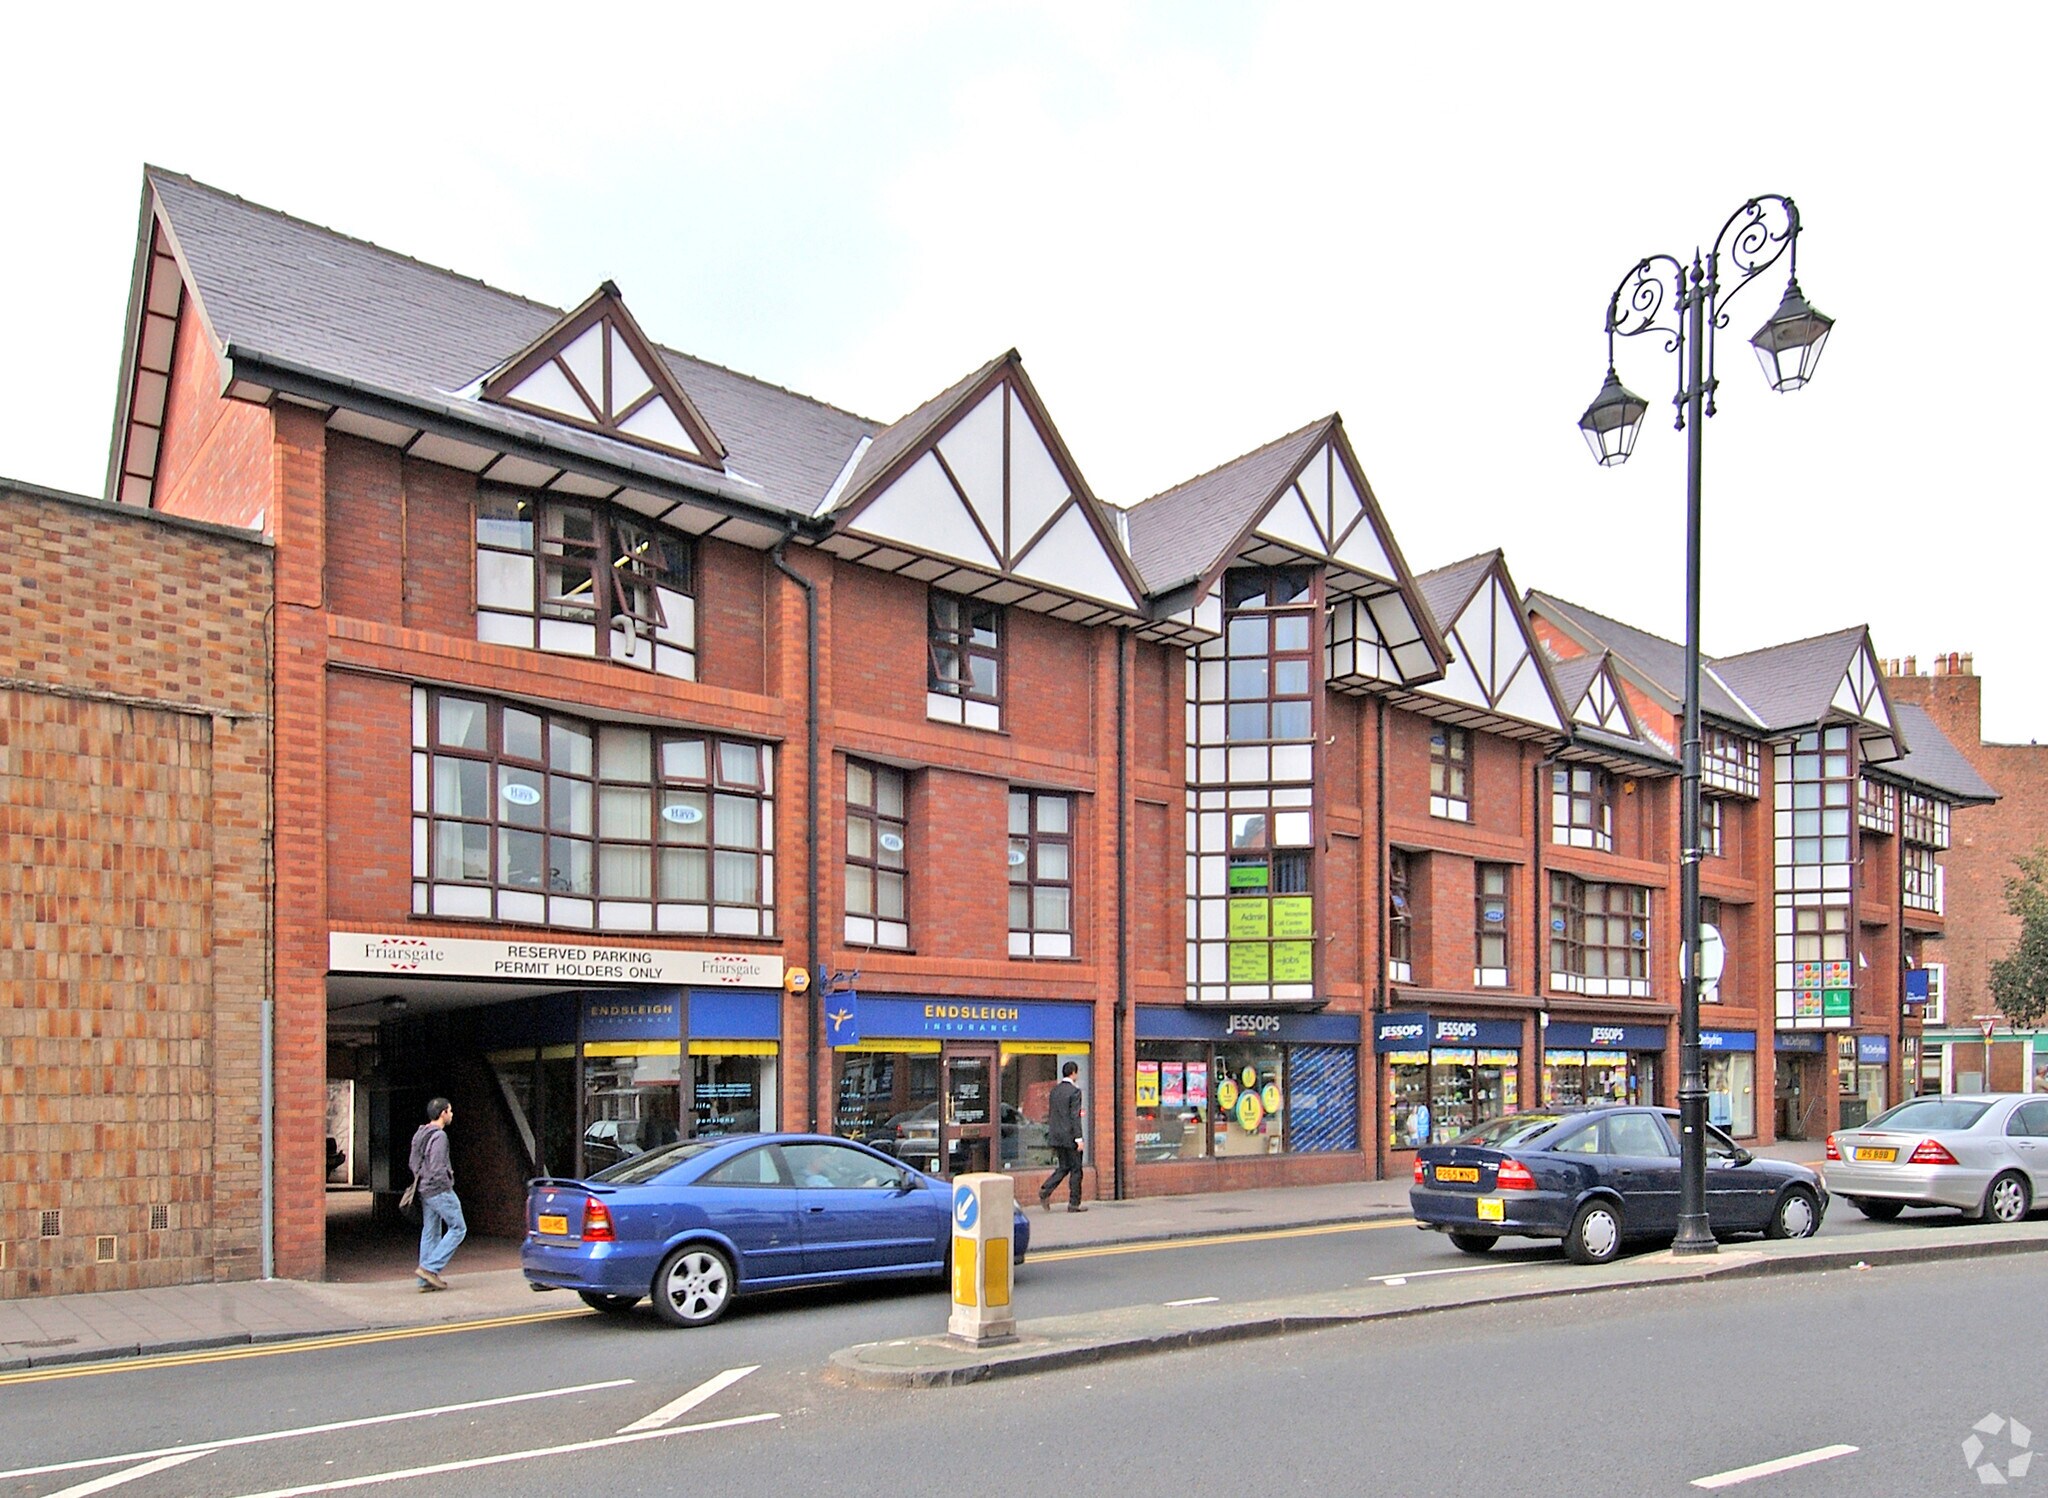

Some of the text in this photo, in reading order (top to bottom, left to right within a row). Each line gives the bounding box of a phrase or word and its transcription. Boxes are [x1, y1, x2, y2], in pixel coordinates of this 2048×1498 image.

[510, 787, 533, 800] Hays
[671, 808, 695, 820] Hays
[1236, 875, 1260, 883] Spring
[1241, 913, 1266, 921] Admin
[364, 943, 445, 963] Friarsgate
[507, 945, 652, 964] RESERVED PARKING
[494, 961, 663, 979] PERMIT HOLDERS ONLY
[701, 960, 761, 977] Friarsgate
[591, 1004, 673, 1016] ENDSLEIGH
[924, 1004, 1019, 1020] ENDSLEIGH
[924, 1023, 1019, 1032] INSURANCE
[1226, 1015, 1280, 1034] JESSOPS
[1436, 1022, 1478, 1039] JESSOPS
[1379, 1025, 1424, 1039] JESSOPS
[1591, 1027, 1624, 1043] JESSOPS
[1246, 1097, 1252, 1111] 1
[696, 1117, 735, 1125] pensions
